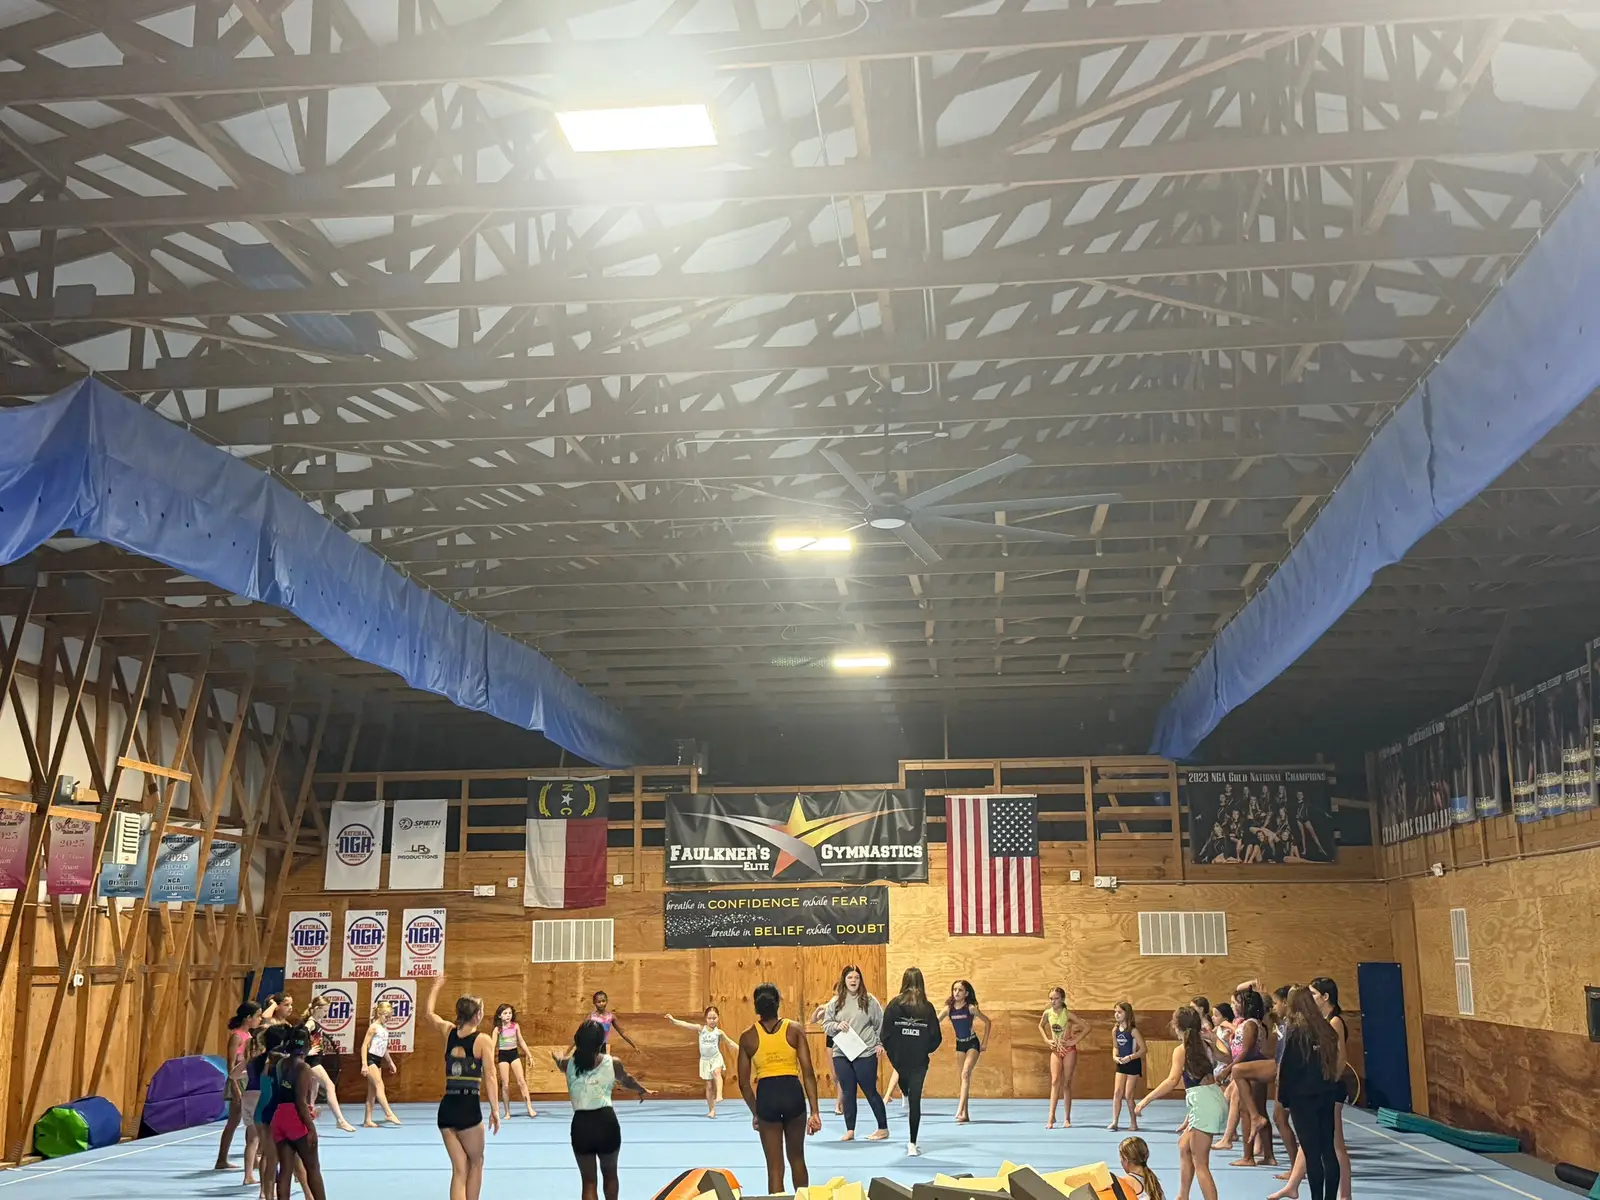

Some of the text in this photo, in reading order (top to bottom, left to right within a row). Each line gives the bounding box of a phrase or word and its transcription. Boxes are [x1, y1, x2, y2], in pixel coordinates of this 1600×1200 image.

[1188, 772, 1209, 783] 2023
[1211, 772, 1226, 782] NGA
[1284, 772, 1326, 782] CHAMPIONS
[339, 836, 371, 853] NGA
[164, 853, 189, 862] 2025
[670, 844, 923, 861] FAULKNER'S GYMNASTICS
[208, 859, 231, 867] 2025
[744, 862, 769, 871] ELITE
[666, 900, 695, 911] breathe
[697, 901, 706, 910] in
[708, 898, 799, 910] CONFIDENCE
[802, 896, 828, 907] exhale
[350, 929, 382, 945] NGA
[408, 927, 440, 943] NGA
[754, 926, 804, 936] BELIEF
[806, 924, 831, 936] exhale
[836, 923, 885, 934] DOUBT
[294, 930, 325, 945] NGA
[328, 1002, 350, 1018] GA
